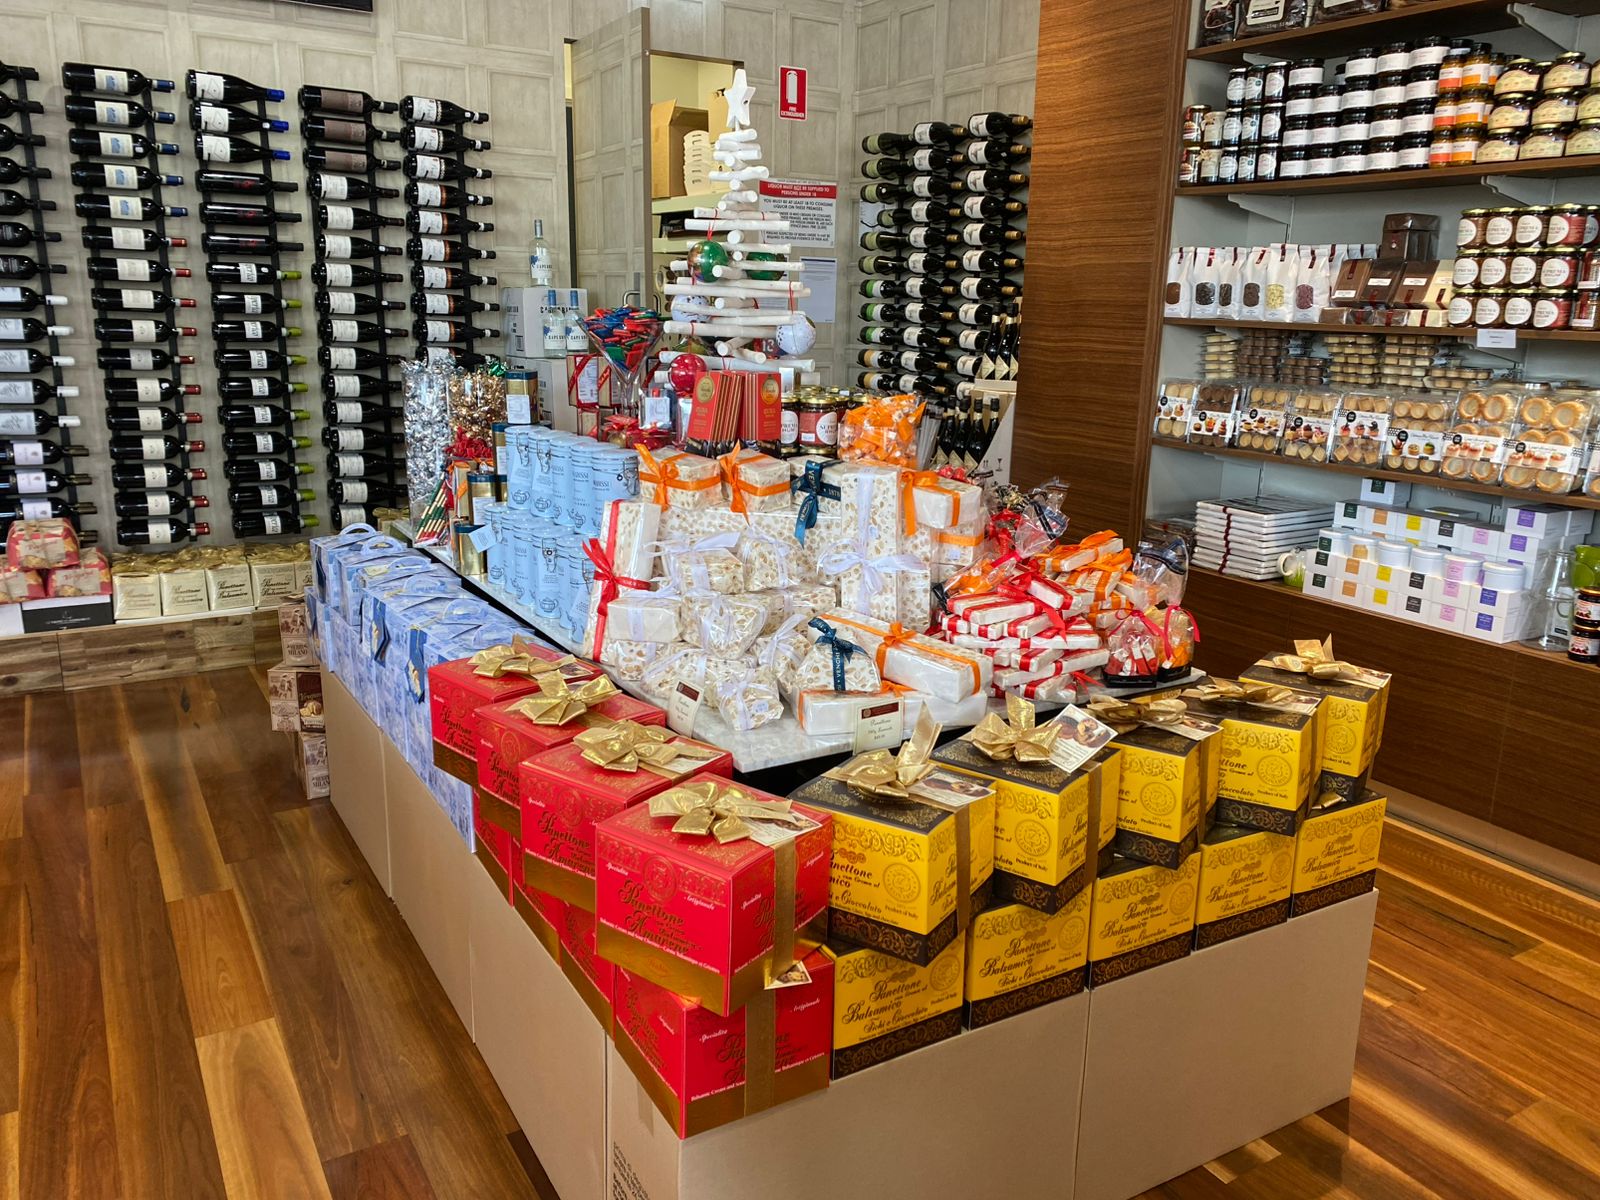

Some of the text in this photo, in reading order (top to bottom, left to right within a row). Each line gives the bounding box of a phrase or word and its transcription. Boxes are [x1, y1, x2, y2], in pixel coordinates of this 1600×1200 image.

[538, 810, 590, 848] Panettone
[1321, 841, 1355, 858] Panettone
[830, 860, 873, 879] anettone
[1302, 856, 1341, 874] Balsamico
[1227, 868, 1264, 886] Panettone
[618, 880, 684, 925] Panettone
[842, 890, 882, 913] Cioccolato
[1206, 886, 1249, 903] Balsamico
[1122, 902, 1164, 921] Panettone
[1100, 919, 1147, 939] Balsamico
[1004, 938, 1051, 958] Panettone
[980, 956, 1033, 977] Balsamico
[869, 980, 921, 1002] Panettone
[842, 1001, 902, 1024] Balsamico
[892, 1008, 928, 1024] Cioccolato
